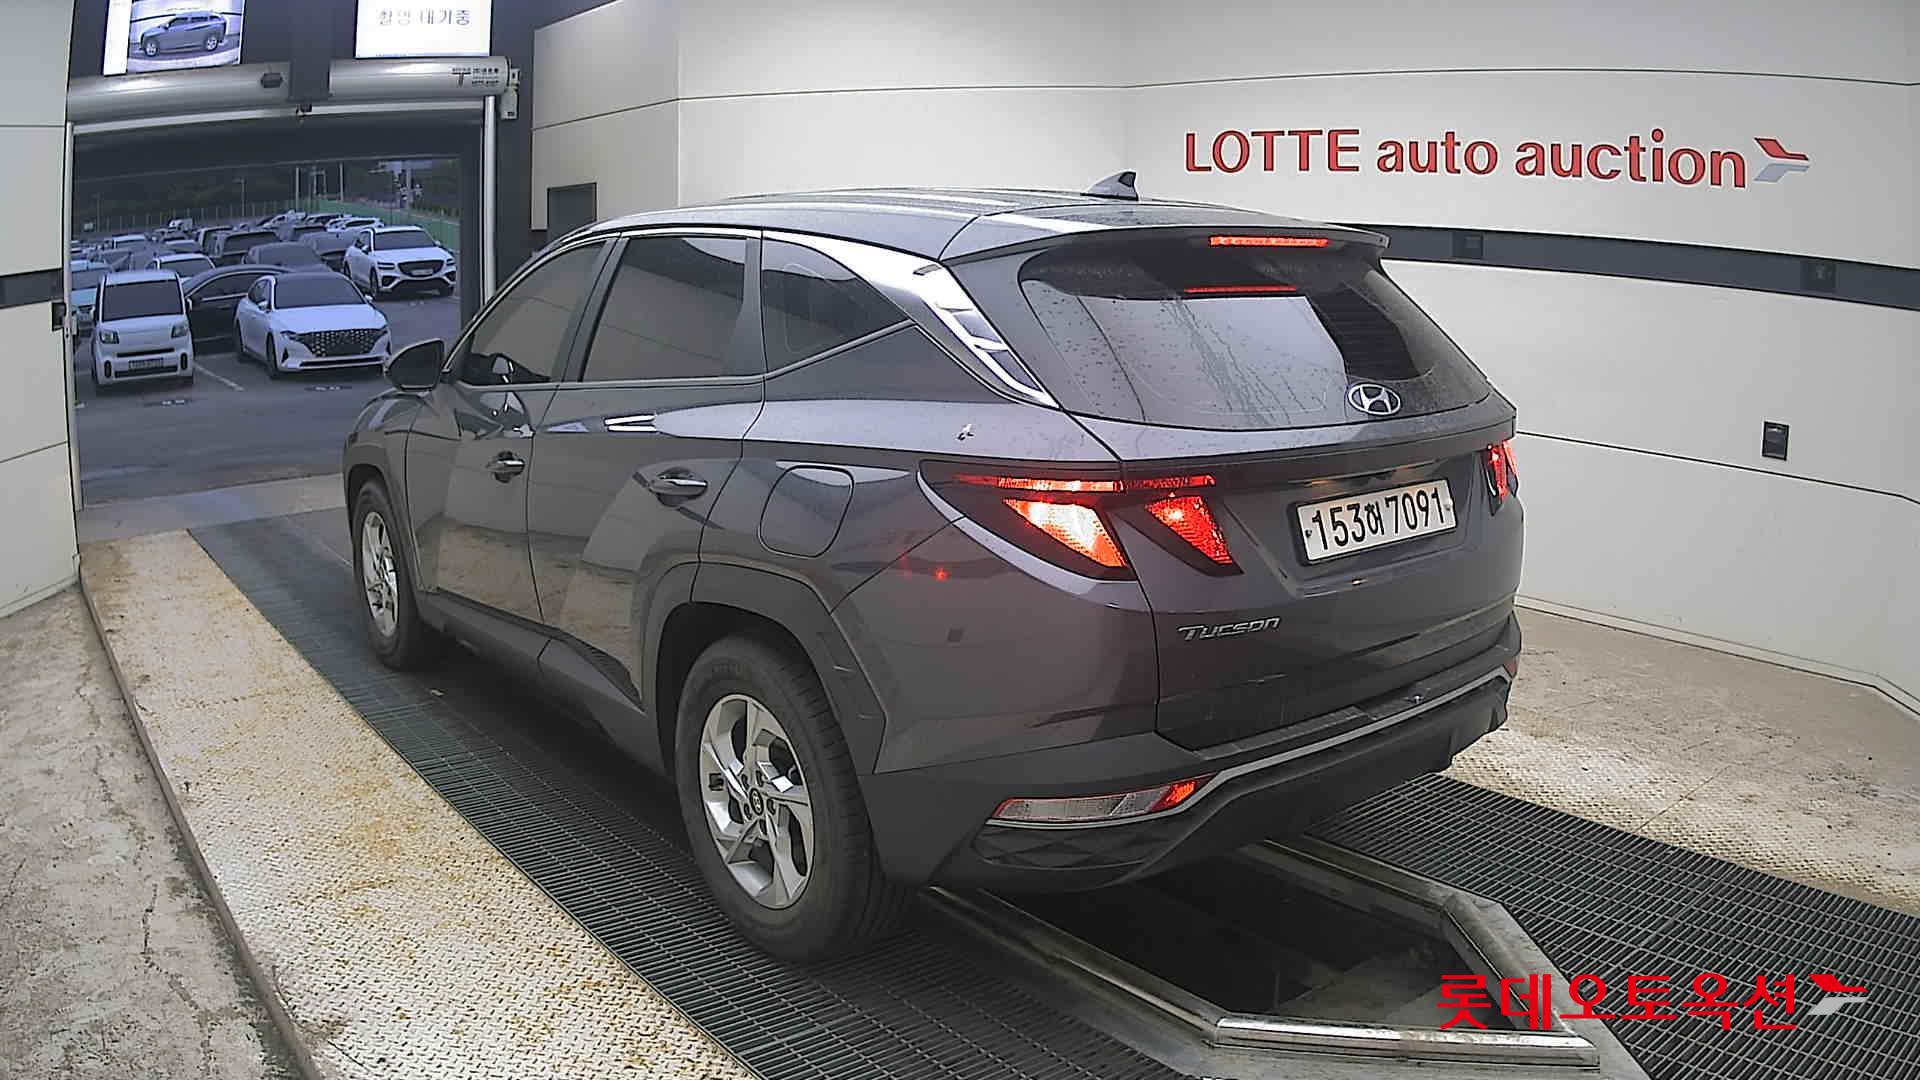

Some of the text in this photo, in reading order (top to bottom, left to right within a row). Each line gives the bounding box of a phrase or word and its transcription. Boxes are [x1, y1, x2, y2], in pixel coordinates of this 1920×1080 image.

[419, 8, 471, 26] 대기중
[1185, 128, 1746, 188] LOTTE auto auction
